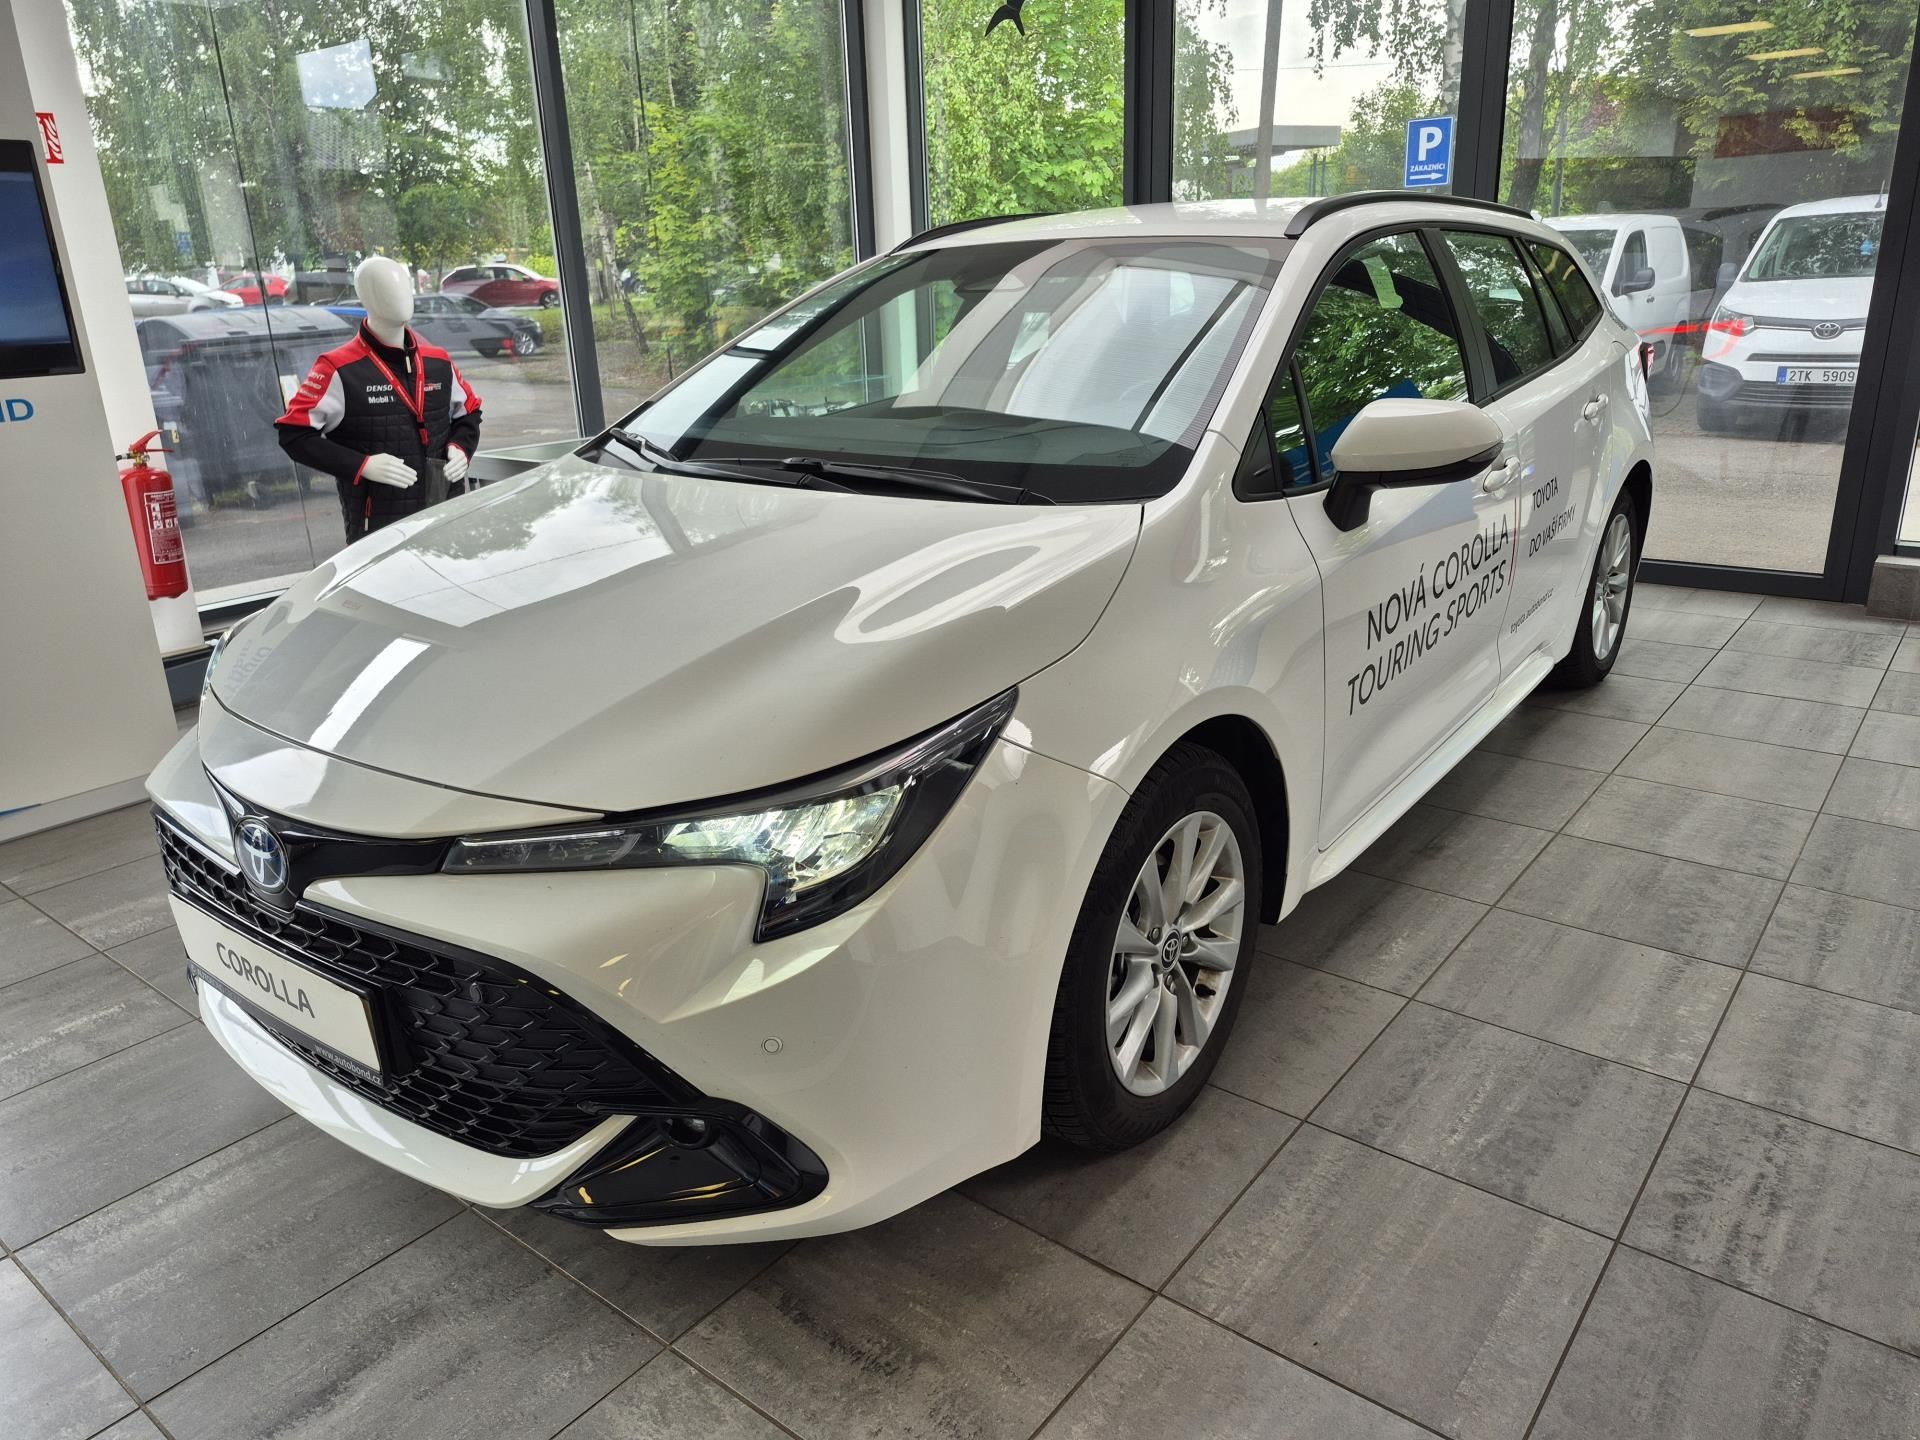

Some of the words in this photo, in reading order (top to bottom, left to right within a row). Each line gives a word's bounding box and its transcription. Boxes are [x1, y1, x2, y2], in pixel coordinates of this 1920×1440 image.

[1418, 126, 1442, 161] P
[1410, 163, 1446, 172] ZÁKAZNÍCI
[366, 384, 393, 392] DENSO
[1789, 370, 1812, 381] 2TK
[1823, 370, 1855, 382] 5909
[368, 395, 389, 404] Mobil
[1532, 476, 1559, 511] TOYOTA
[1529, 533, 1541, 557] DO
[1542, 513, 1558, 546] VAŠÍ
[1557, 503, 1577, 533] FIRMY
[1367, 563, 1426, 650] NOVÁ
[1432, 514, 1509, 599] COROLLA
[1348, 613, 1441, 716] TOURING
[1444, 560, 1507, 636] SPORTS
[216, 941, 316, 1019] COROLLA
[315, 1045, 381, 1085] www.autobond.cz
